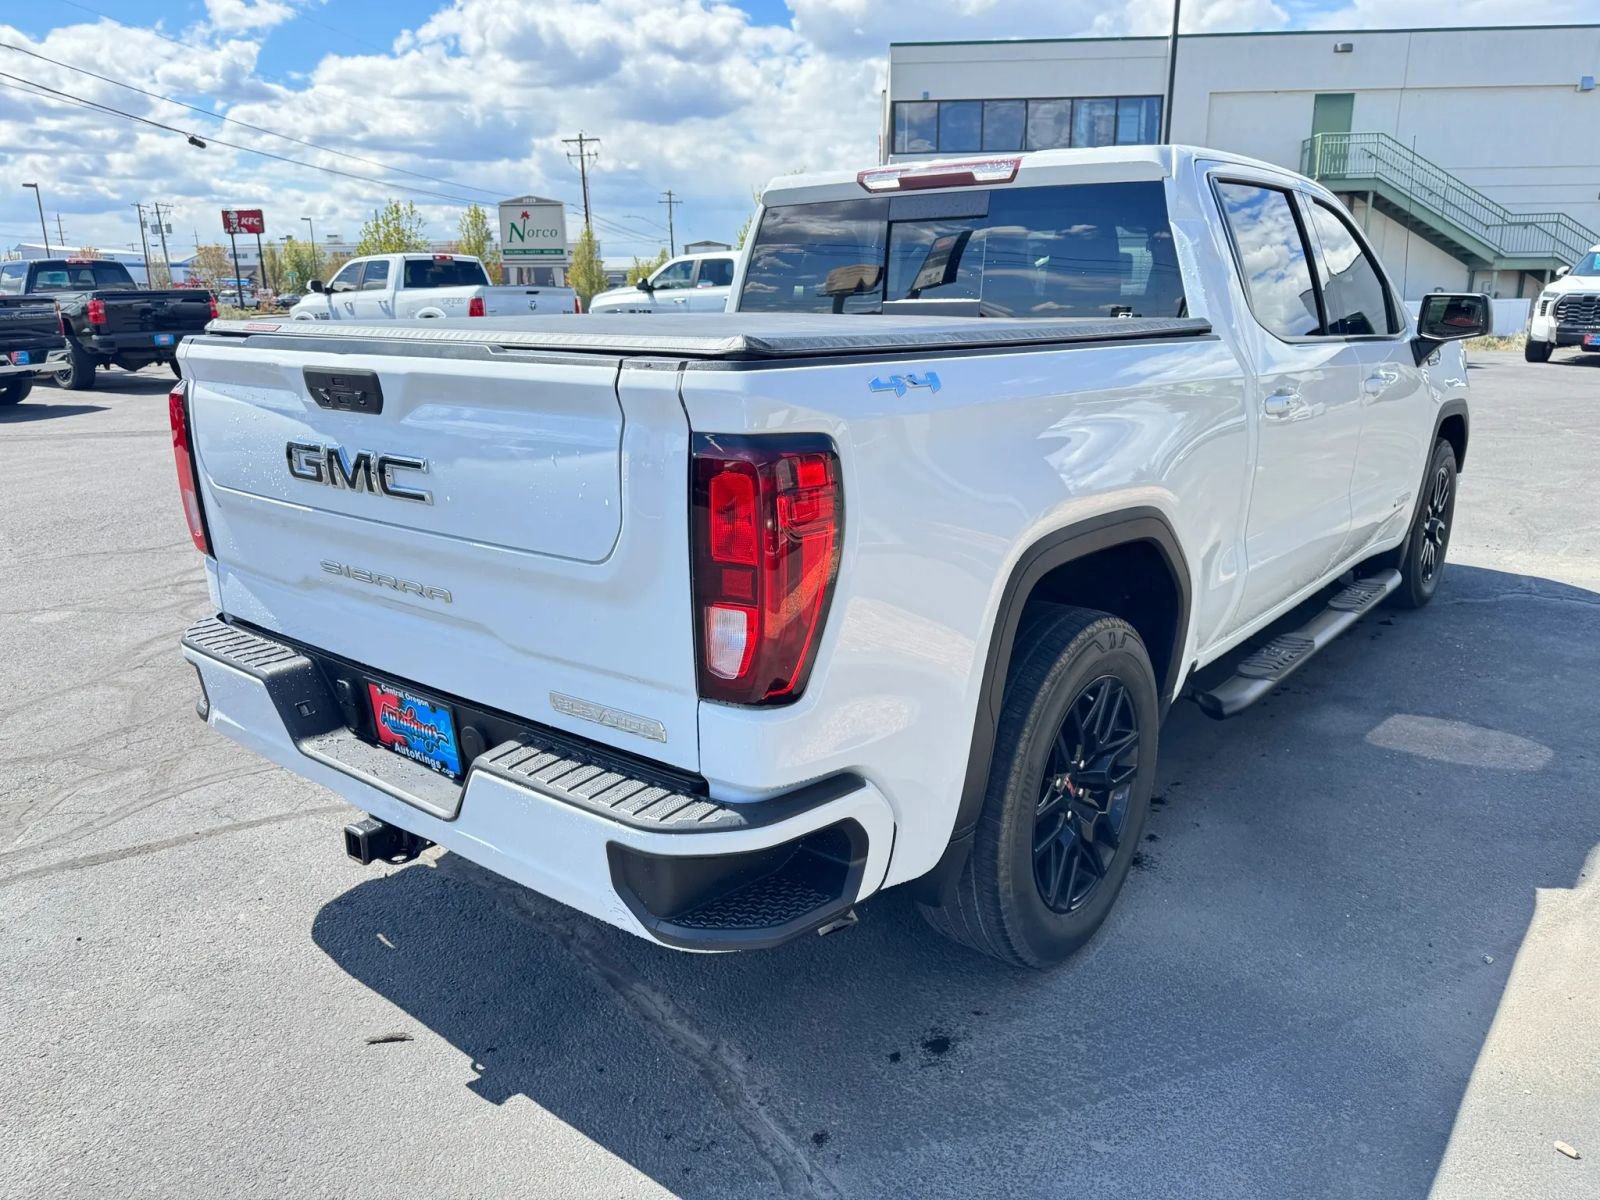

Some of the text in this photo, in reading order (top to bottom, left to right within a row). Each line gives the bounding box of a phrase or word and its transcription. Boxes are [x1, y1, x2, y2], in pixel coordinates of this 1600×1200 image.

[240, 217, 260, 225] KFC
[508, 219, 558, 243] Norco
[286, 441, 434, 506] GMC
[320, 558, 453, 603] SIERRA
[381, 684, 430, 708] Central Oregon
